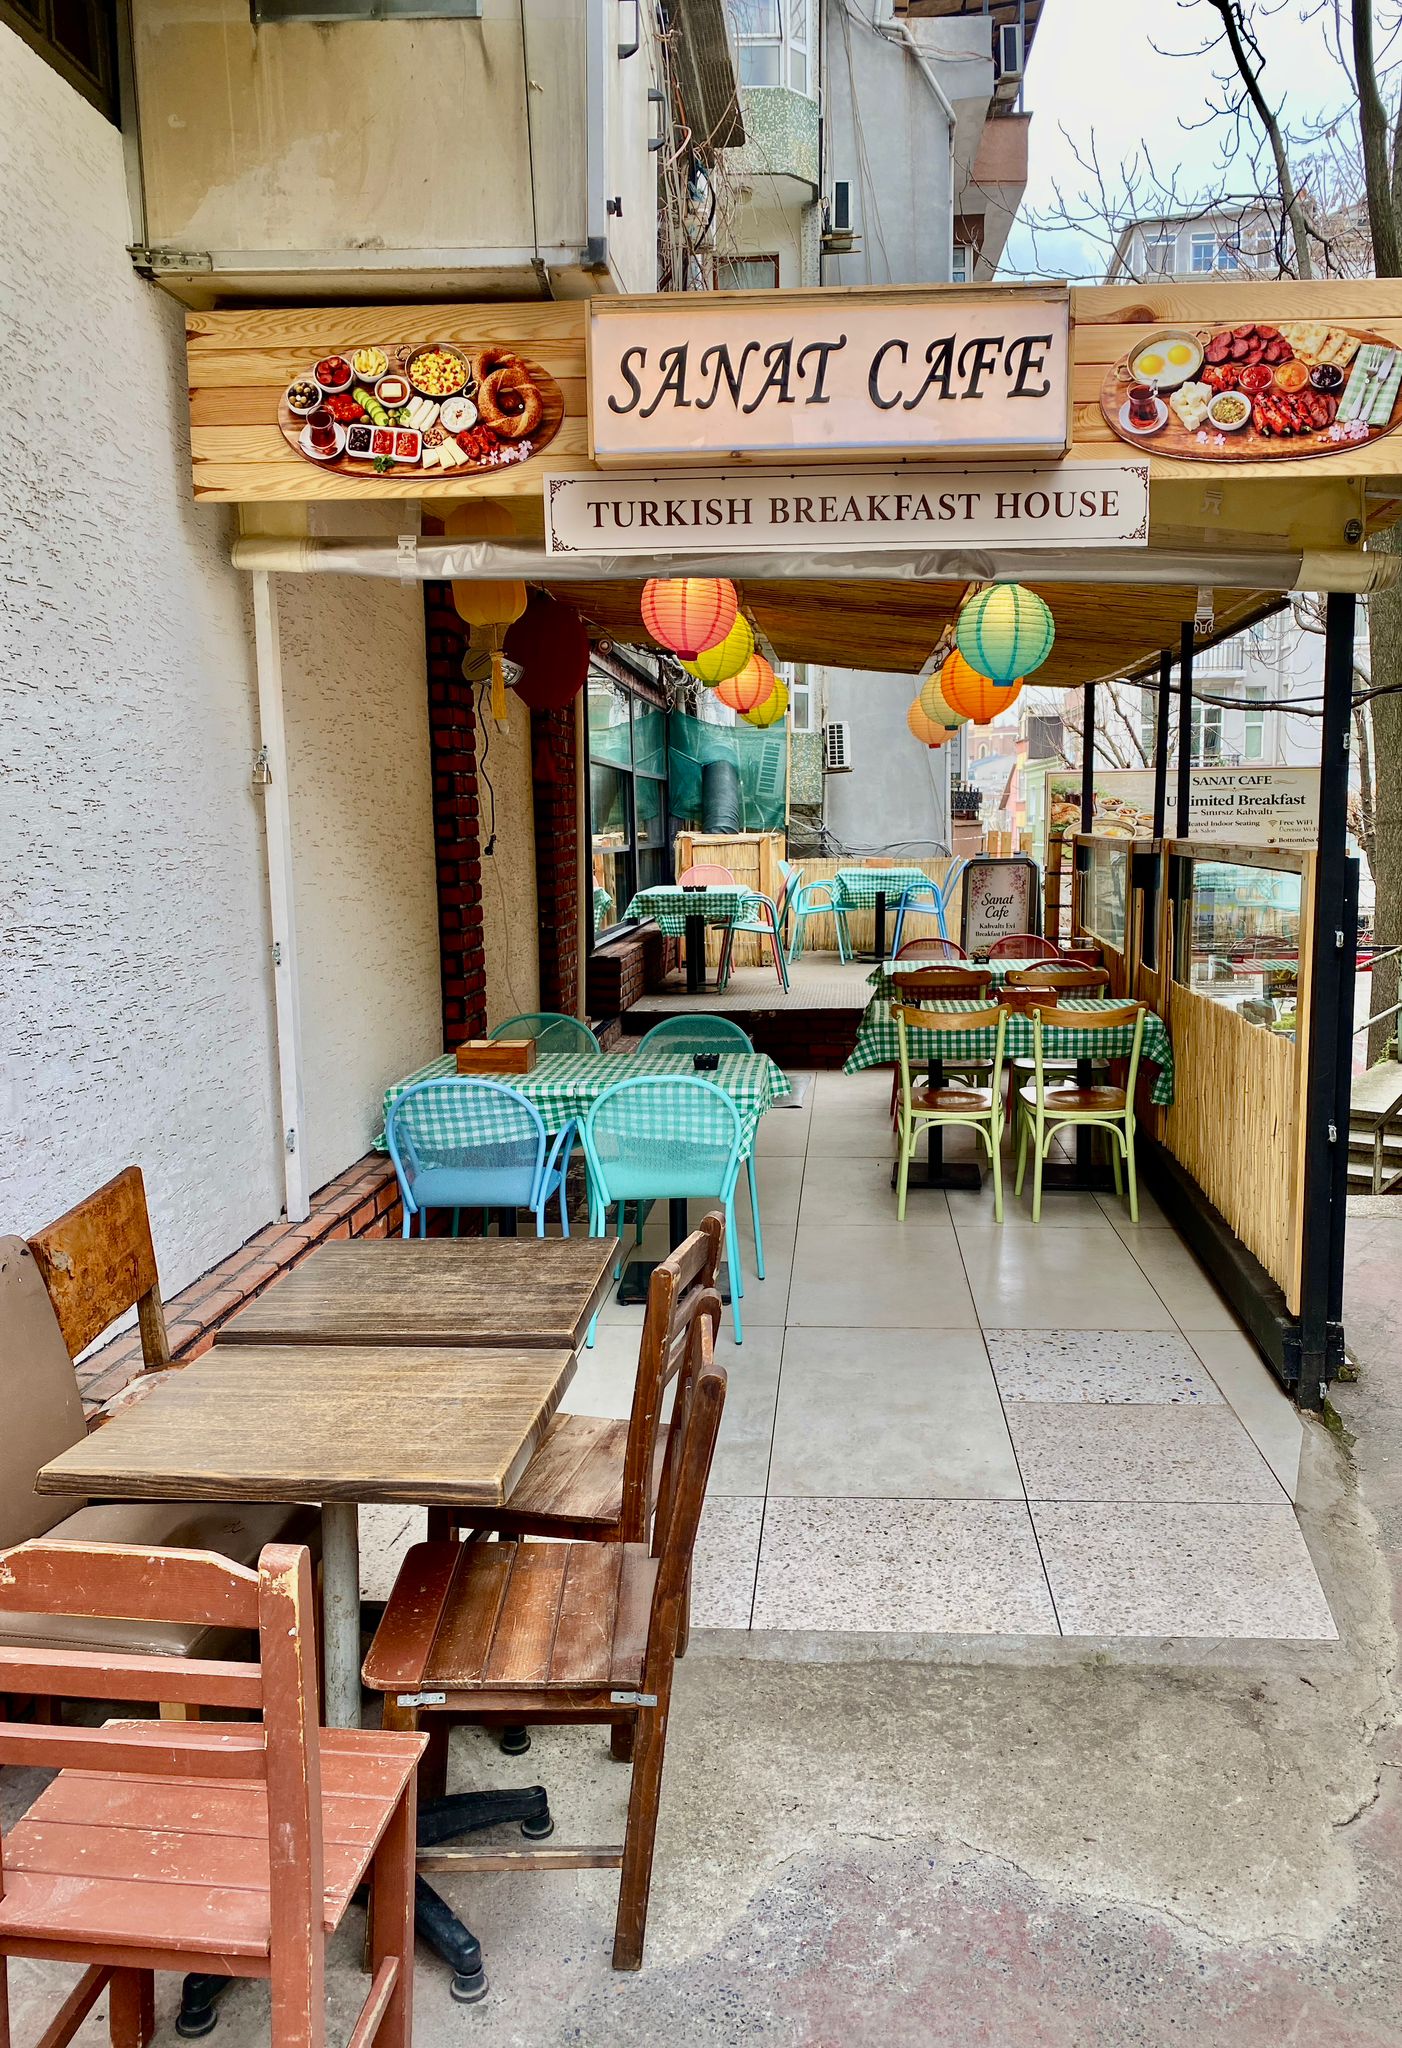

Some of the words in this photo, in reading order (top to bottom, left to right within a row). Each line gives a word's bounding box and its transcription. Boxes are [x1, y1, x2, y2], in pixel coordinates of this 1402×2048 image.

[607, 334, 848, 419] SANAT
[867, 332, 1054, 411] CAFE
[586, 497, 753, 528] TURKISH
[768, 492, 981, 525] BREAKFAST
[994, 490, 1120, 520] HOUSE
[1192, 776, 1236, 786] SANAT
[1238, 776, 1272, 785] CAFE
[1166, 794, 1234, 807] Uimited
[1239, 794, 1306, 805] Breakfast
[981, 893, 1014, 906] Sanat
[985, 905, 1009, 920] Cafe
